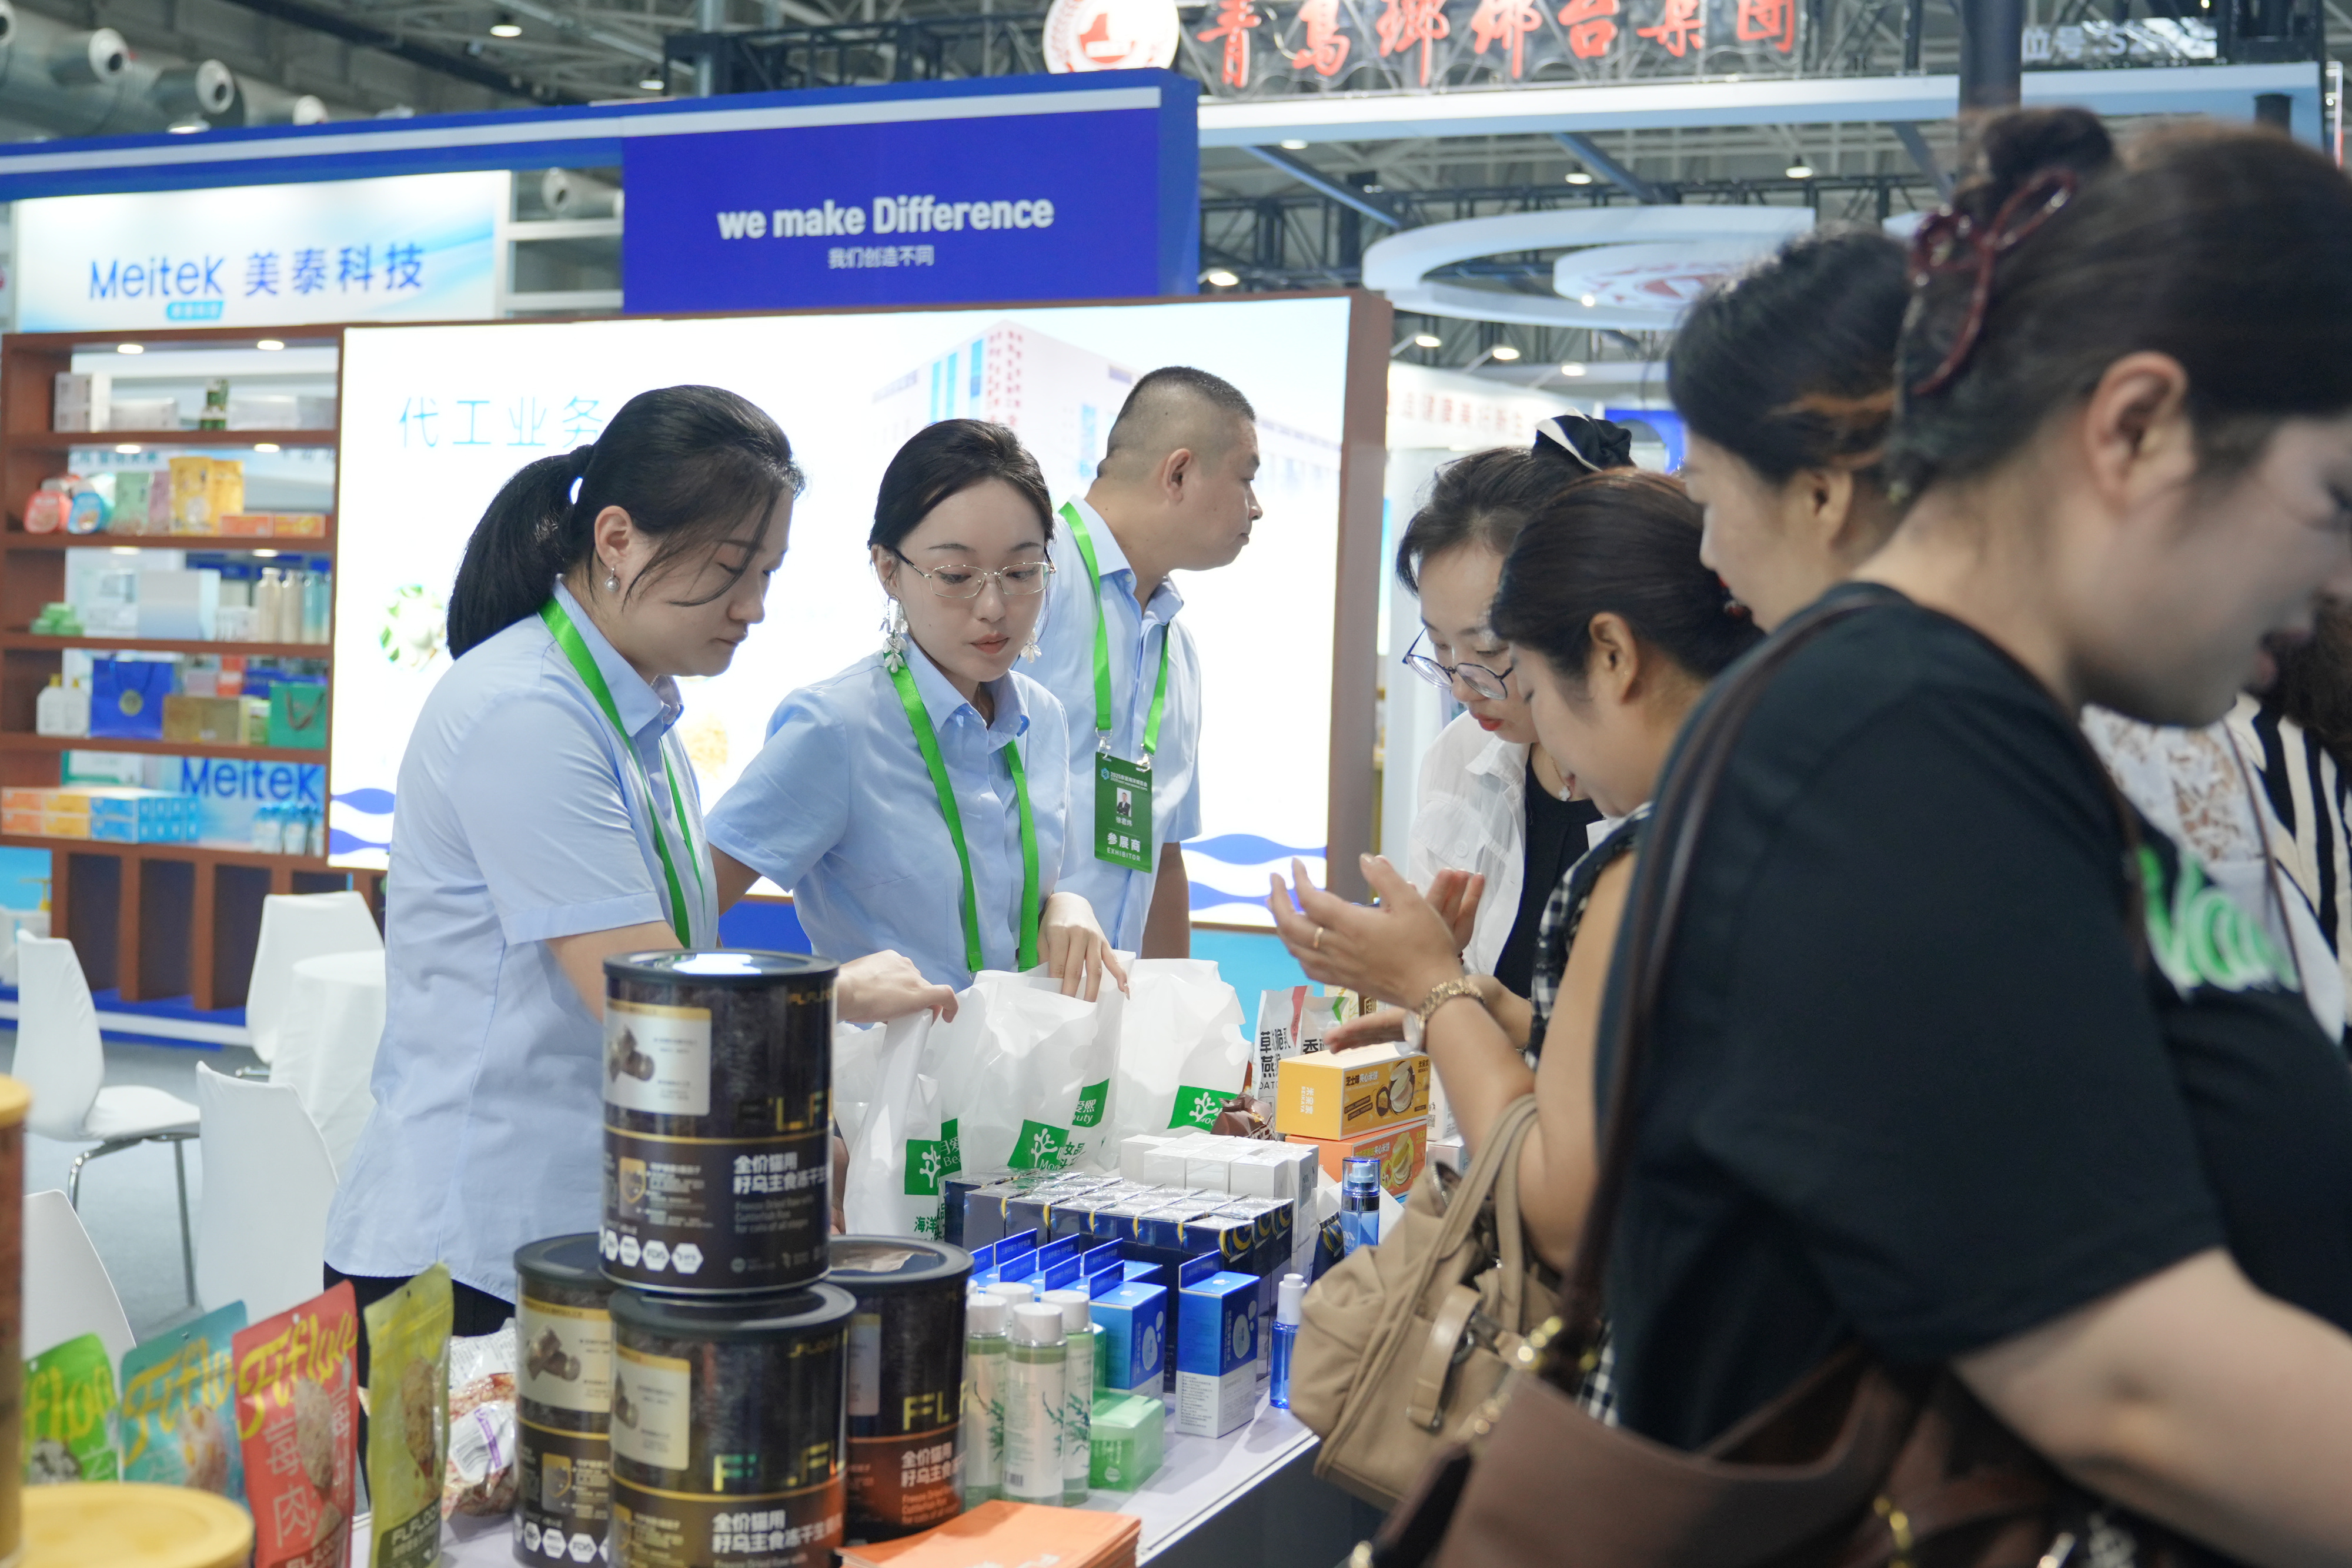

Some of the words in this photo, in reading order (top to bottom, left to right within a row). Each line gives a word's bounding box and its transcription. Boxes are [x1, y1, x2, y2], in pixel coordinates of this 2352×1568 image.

[716, 211, 767, 240] we
[773, 199, 866, 238] make
[873, 195, 1055, 234] Difference
[245, 243, 424, 296] 美泰科技
[828, 245, 935, 269] 我们创造不同
[399, 395, 603, 449] 代工业务
[1107, 832, 1141, 852] 参展商
[1107, 847, 1141, 862] EXHIBITOR
